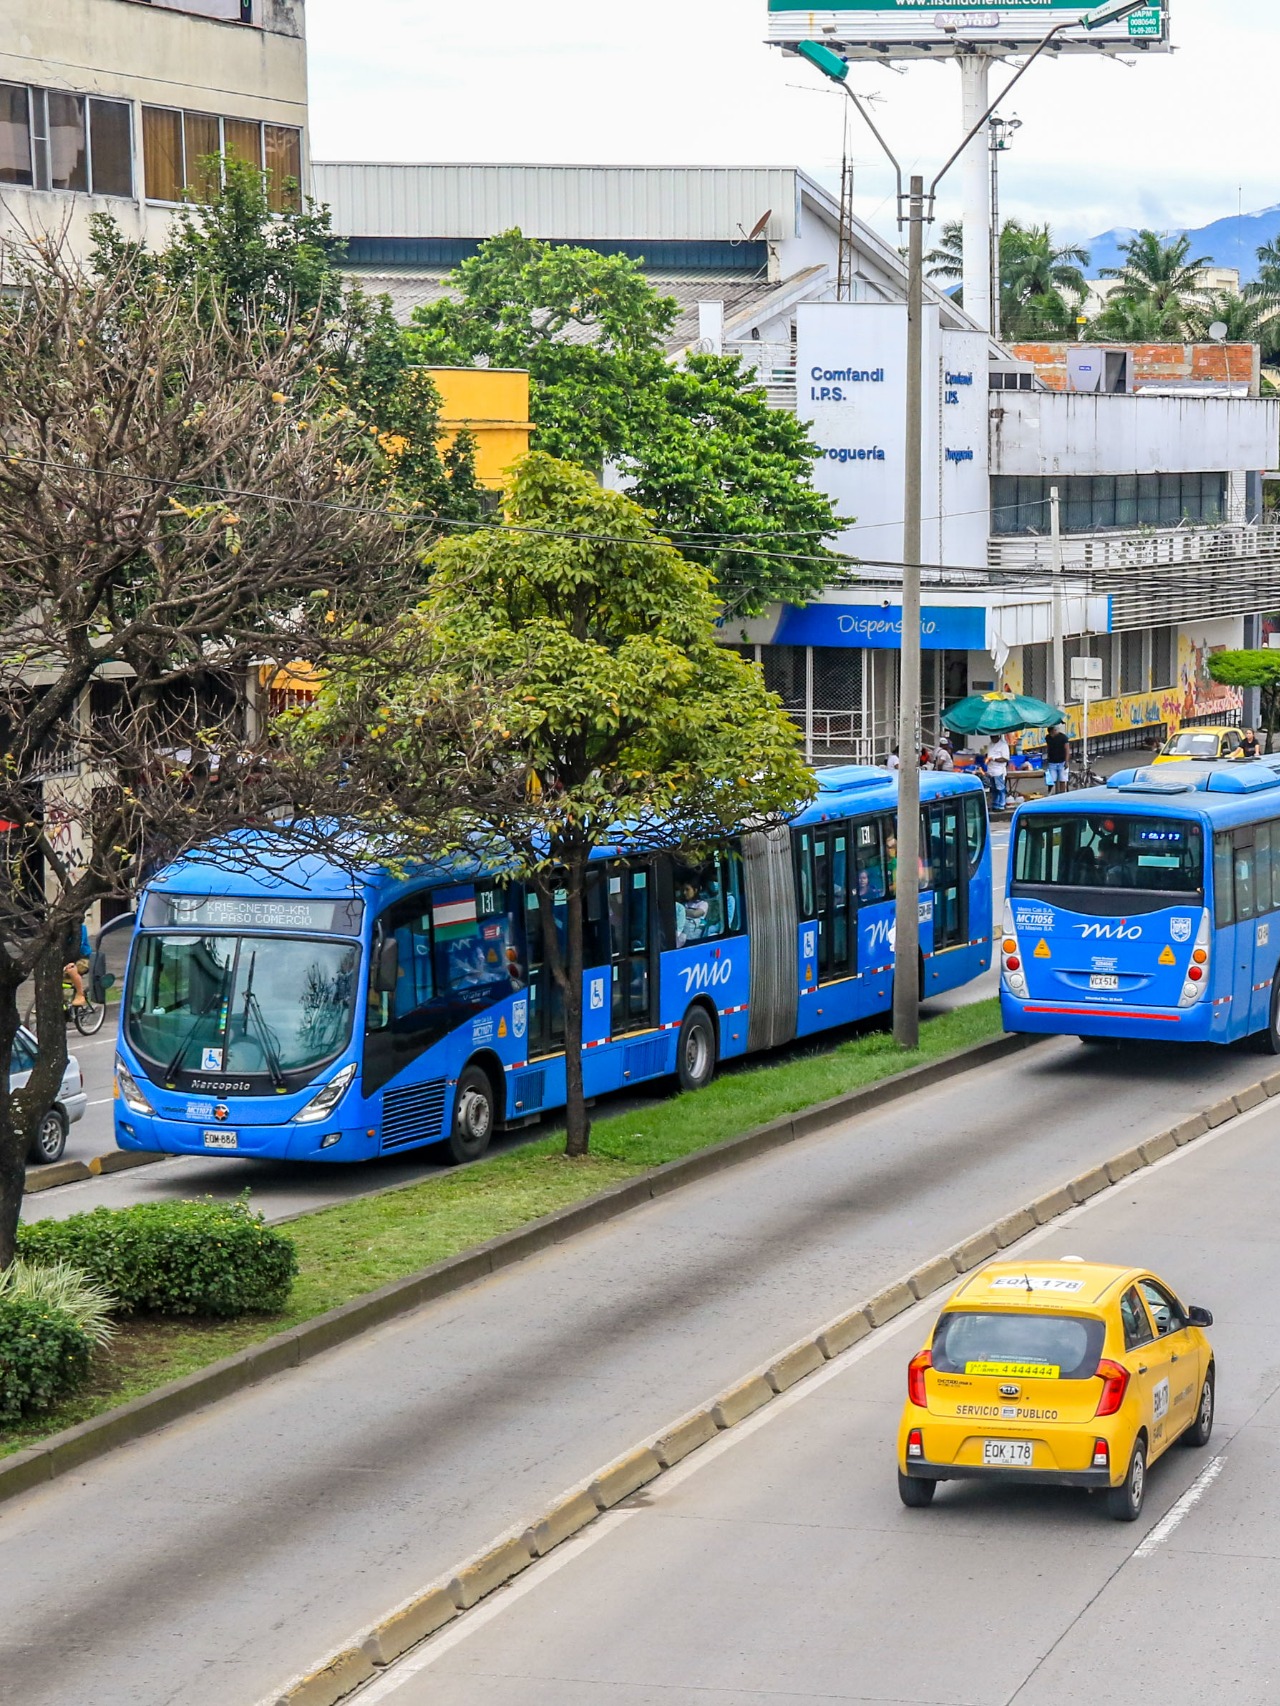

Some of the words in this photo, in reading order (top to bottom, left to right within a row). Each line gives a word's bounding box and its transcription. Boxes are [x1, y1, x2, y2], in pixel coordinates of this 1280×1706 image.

[1130, 26, 1157, 34] 16-09-2022
[811, 366, 884, 382] Comfandi
[811, 386, 847, 401] I.P.S.
[837, 614, 936, 640] Dispensio
[480, 890, 495, 914] T31
[171, 898, 198, 922] T31
[220, 913, 251, 923] PASO
[255, 914, 312, 926] COMERCIO
[1016, 914, 1054, 924] MC11056
[191, 1079, 251, 1091] Marcopolo
[1002, 1386, 1016, 1394] KIA
[956, 1405, 999, 1416] SERVICIO
[1016, 1408, 1058, 1420] PUBLICO
